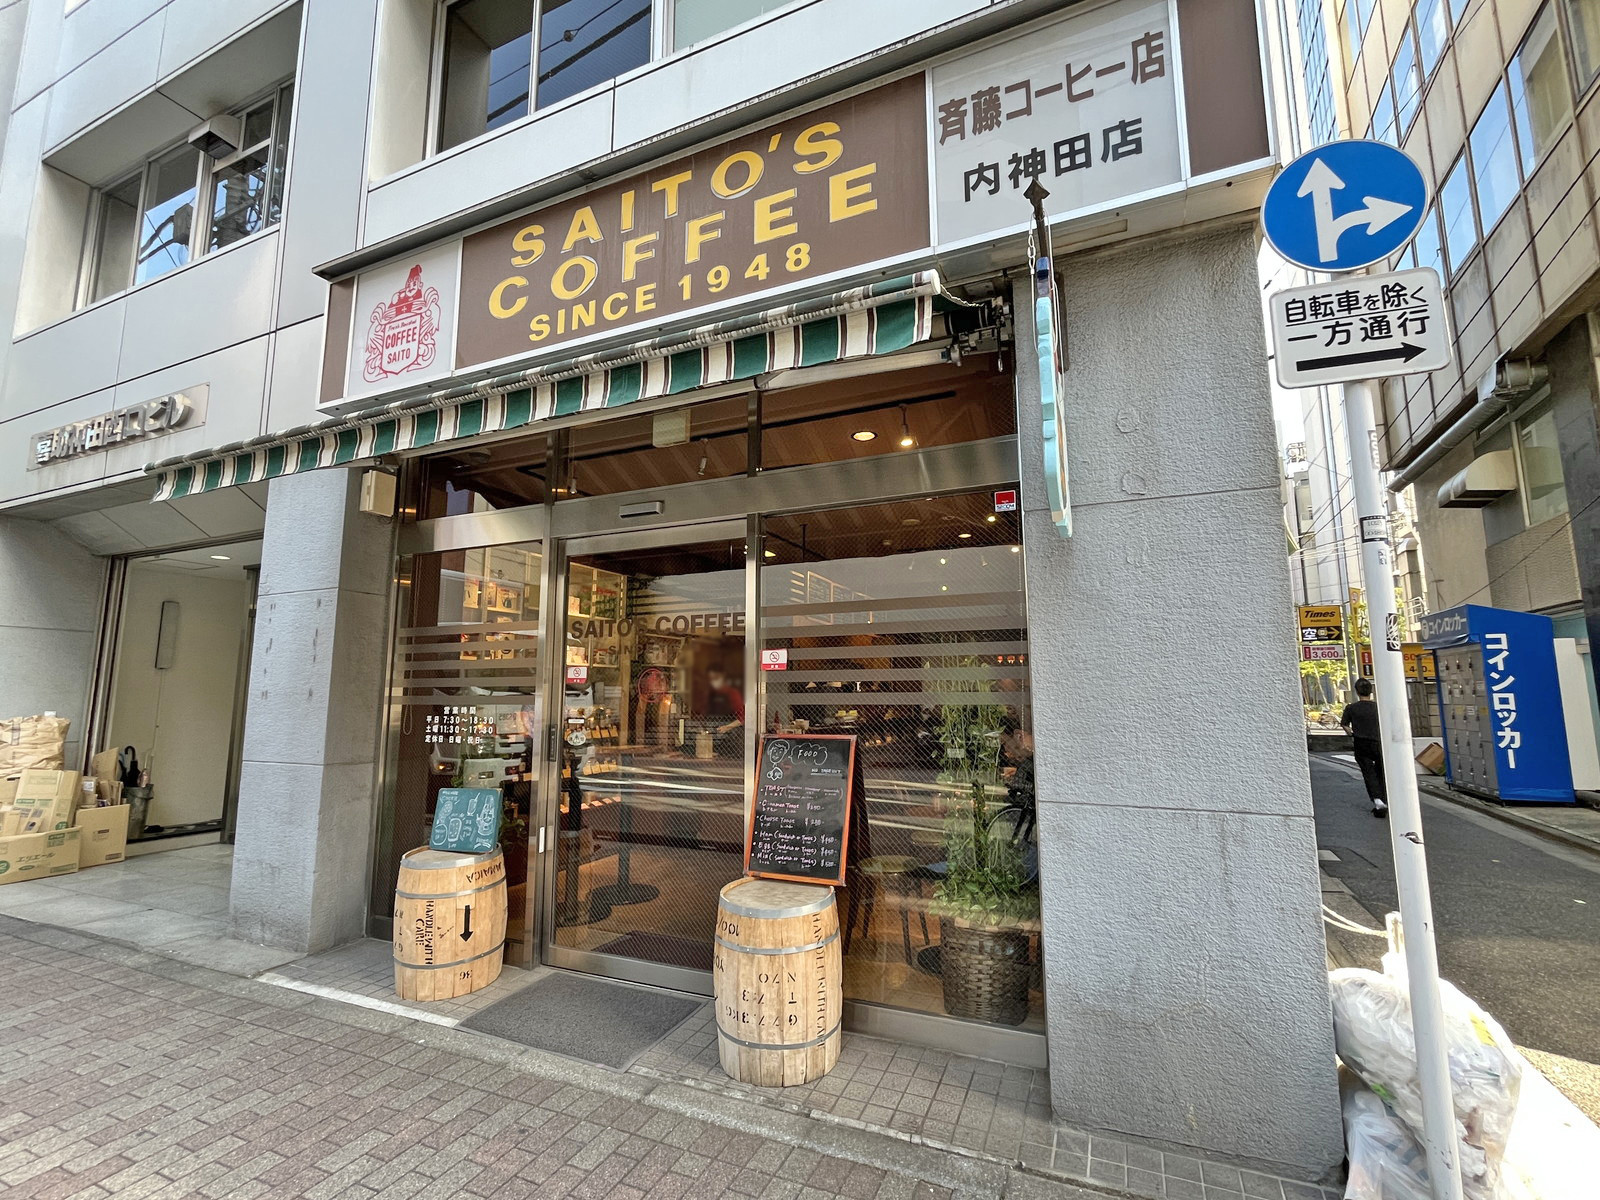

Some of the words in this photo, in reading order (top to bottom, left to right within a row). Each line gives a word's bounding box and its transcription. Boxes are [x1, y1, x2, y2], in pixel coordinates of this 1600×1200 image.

[938, 31, 1165, 145] 斉藤コーヒー店
[964, 118, 1143, 202] 内神田店
[510, 121, 844, 268] SAITO'S
[488, 162, 878, 319] COFFEE
[529, 282, 657, 342] SINCE
[677, 242, 811, 301] 1948
[1285, 282, 1427, 323] 自転車を除く
[385, 326, 418, 349] COFFEE
[1288, 308, 1430, 347] 一方通行
[387, 348, 411, 364] SAITO
[655, 611, 746, 635] COFFEE
[1304, 610, 1336, 618] Times
[1429, 613, 1467, 635] コインロッカー
[1302, 628, 1318, 641] 空
[444, 706, 477, 715] 営業時間
[1485, 633, 1521, 769] コインロッカー
[425, 725, 439, 733] 土曜
[426, 715, 440, 723] 平日
[425, 735, 444, 743] 定休日
[466, 861, 502, 883] JAMAICA
[415, 918, 425, 946] CARE
